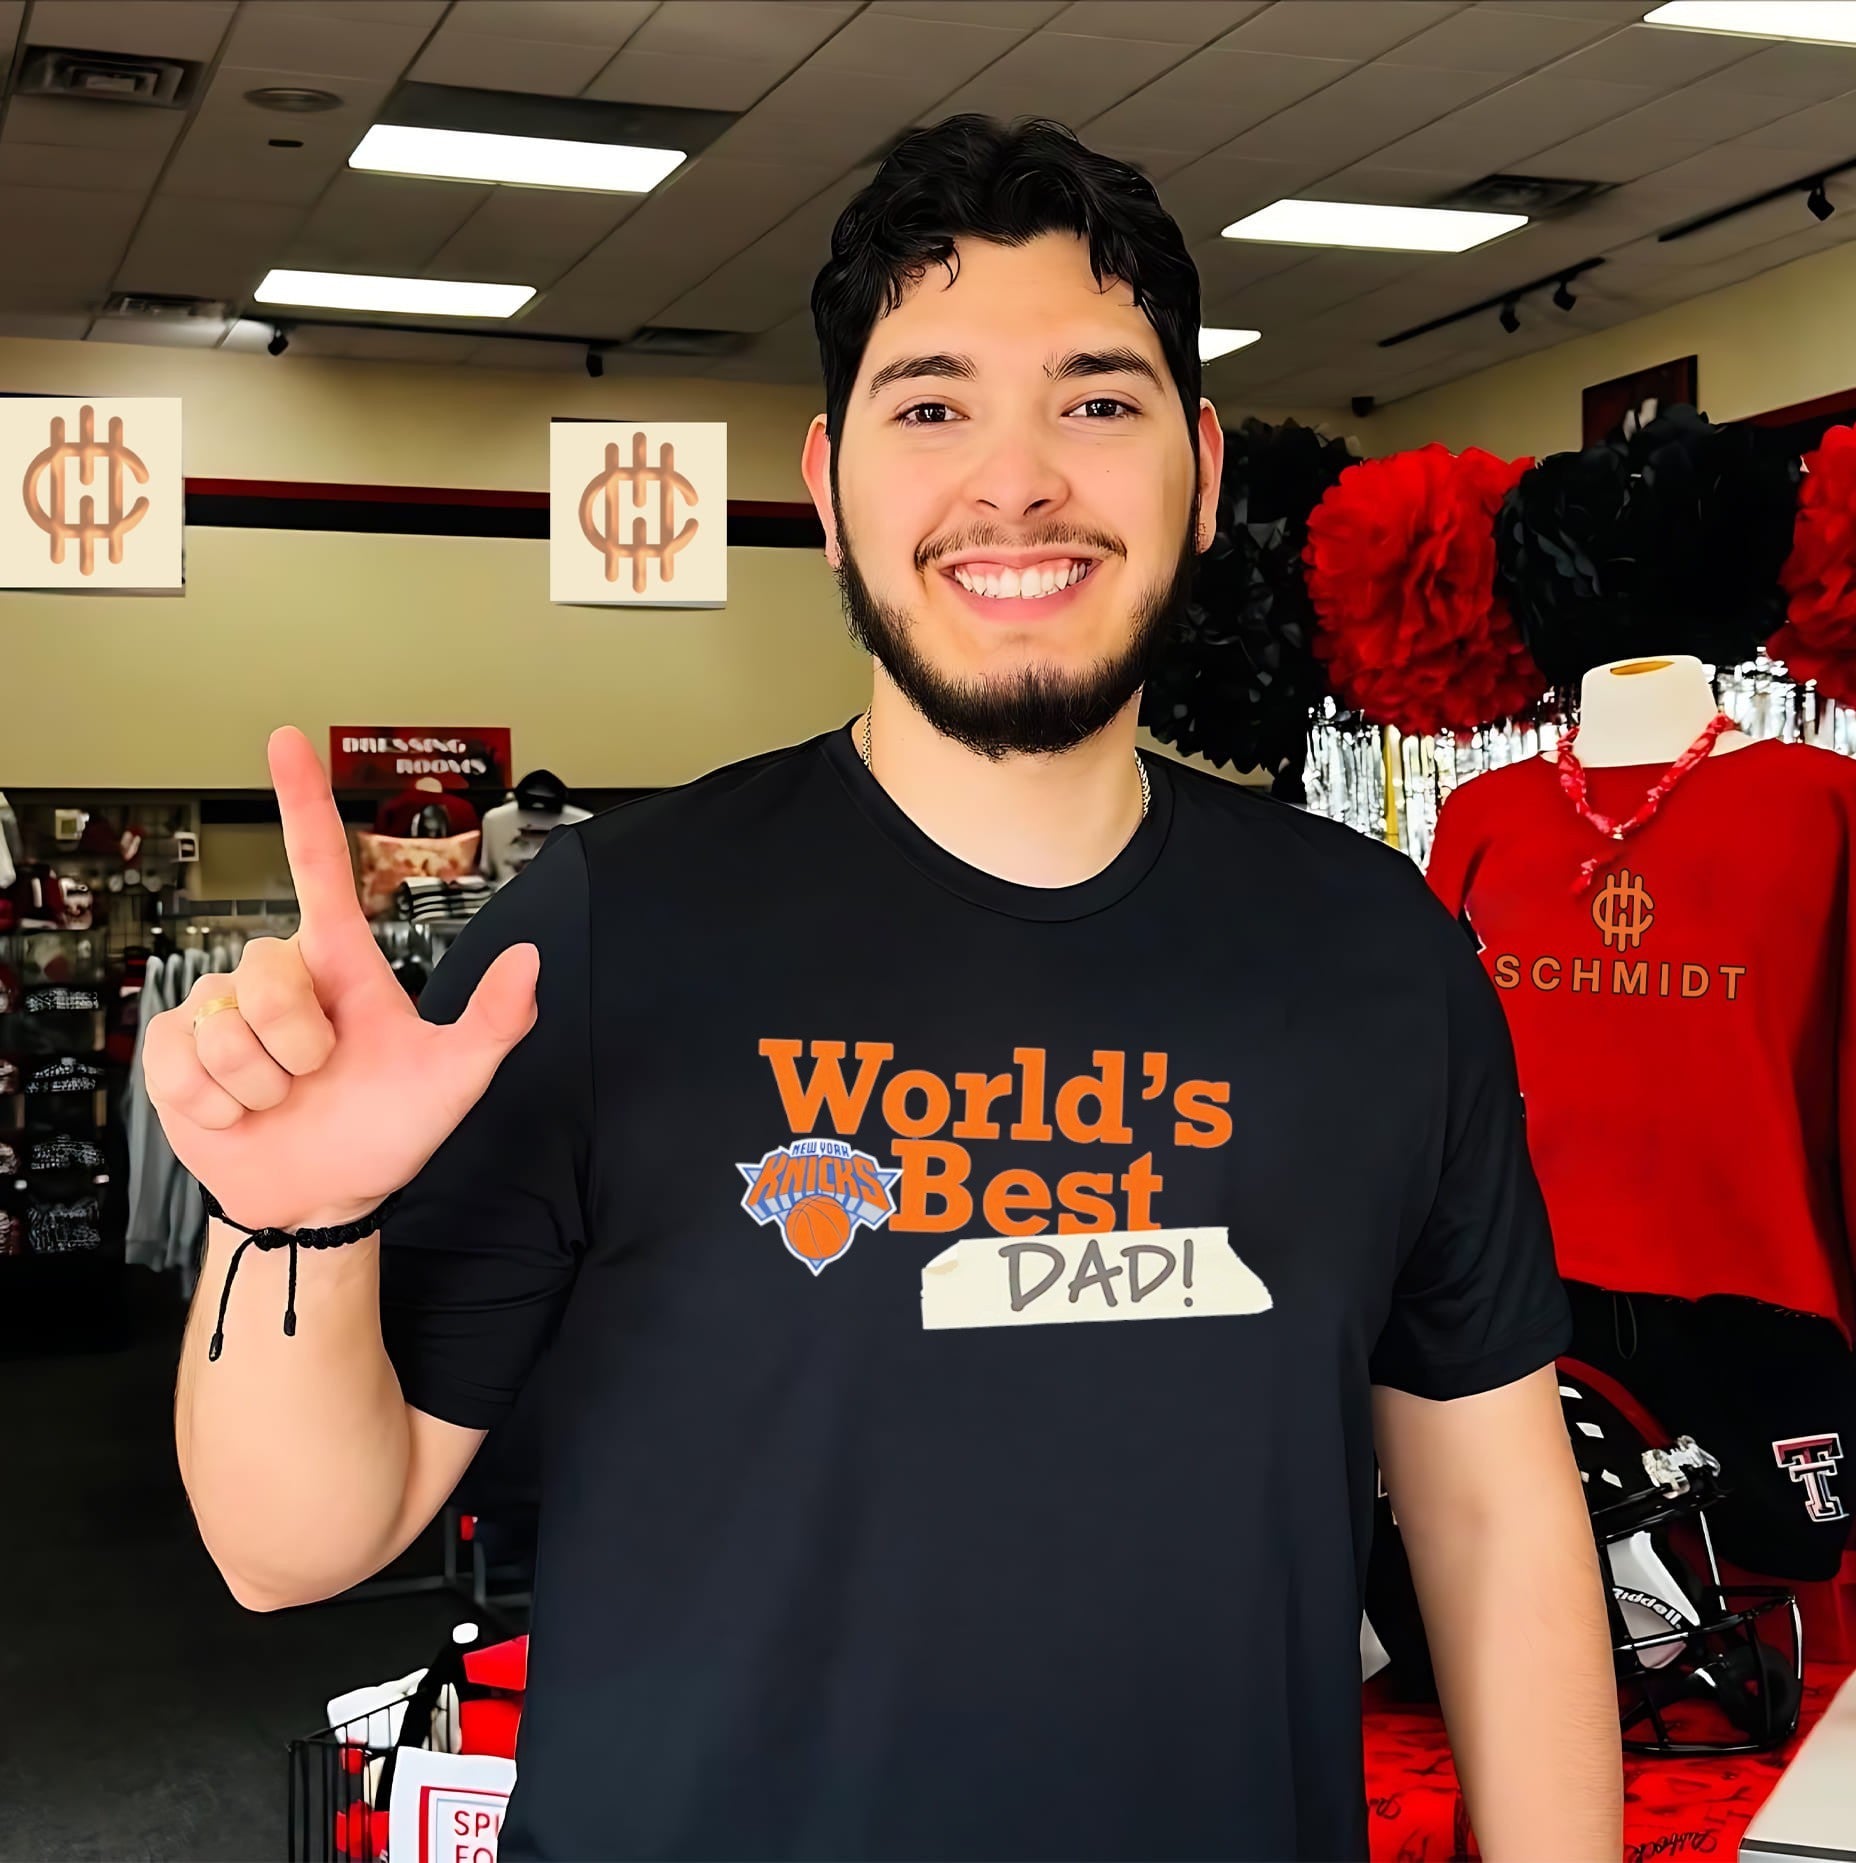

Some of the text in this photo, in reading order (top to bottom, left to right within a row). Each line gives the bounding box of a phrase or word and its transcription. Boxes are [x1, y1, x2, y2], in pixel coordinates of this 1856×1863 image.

[341, 737, 467, 753] DRESSING
[396, 758, 487, 774] ROOMS
[1494, 953, 1747, 1000] SCHMIDT
[758, 1038, 1234, 1149] World's
[791, 1141, 851, 1158] NEW YORK
[747, 1153, 891, 1211] KNICKS
[888, 1138, 1163, 1237] Best
[998, 1238, 1194, 1312] DAD!
